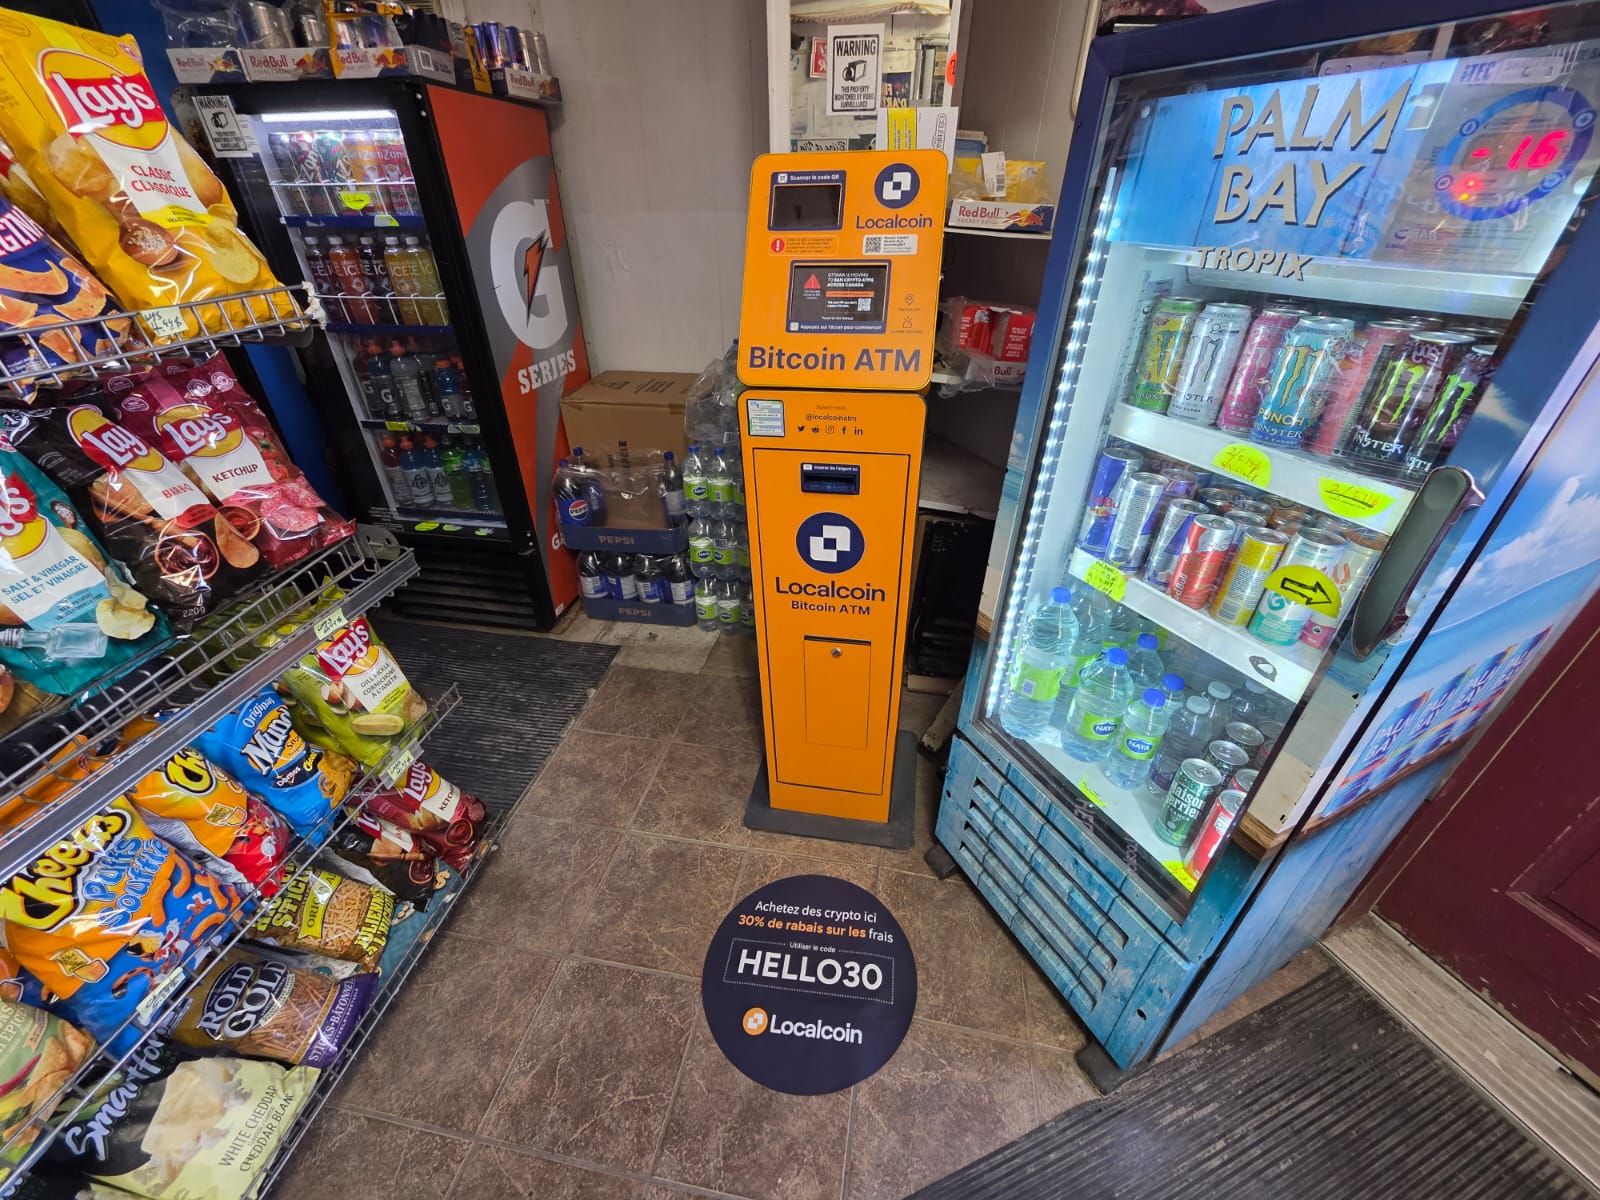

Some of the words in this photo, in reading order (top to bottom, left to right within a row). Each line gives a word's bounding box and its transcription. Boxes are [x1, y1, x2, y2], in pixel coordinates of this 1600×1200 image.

[250, 56, 269, 68] Red
[269, 55, 288, 68] Bull
[353, 51, 369, 63] Bull
[835, 40, 876, 57] WARNING
[51, 72, 156, 129] Lay's
[1213, 77, 1412, 160] PALM
[130, 165, 176, 183] CLASSIC
[130, 180, 192, 199] CLASSIQUE
[1213, 159, 1366, 228] BAY
[856, 214, 933, 230] Localcoin
[959, 206, 979, 218] Red
[979, 207, 1000, 218] Bull
[490, 198, 568, 349] G
[1198, 247, 1313, 281] TROPIX
[518, 350, 577, 394] SERIES
[749, 346, 846, 371] Bitcoin
[854, 349, 921, 372] ATM
[993, 367, 1012, 376] Bull
[805, 413, 857, 422] @localcoinatm
[1256, 408, 1305, 426] PUNCH
[163, 410, 234, 456] Lay's
[212, 463, 259, 483] KETCHUP
[599, 535, 635, 545] PEPSI
[2, 578, 31, 596] SALT
[32, 573, 42, 583] &
[39, 555, 79, 578] VINEGAR
[10, 590, 33, 604] SEL
[33, 583, 47, 596] ET
[47, 562, 89, 587] VINAIGRE
[775, 576, 886, 602] Localcoin
[618, 607, 652, 617] PEPSI
[791, 600, 836, 613] Bitcoin
[839, 604, 871, 615] ATM
[319, 624, 370, 675] Lay's
[243, 696, 276, 728] Original
[1128, 738, 1154, 752] NAYA
[83, 837, 143, 901] Puffs
[755, 901, 800, 916] Achetez
[801, 905, 822, 917] des
[824, 910, 862, 923] crypto
[864, 911, 878, 924] ici
[738, 914, 765, 928] 30%
[767, 917, 784, 930] de
[785, 919, 824, 934] rabais
[826, 926, 846, 937] sur
[848, 926, 867, 938] les
[868, 928, 894, 943] frais
[789, 942, 812, 952] Utiliser
[812, 943, 819, 952] le
[819, 944, 836, 953] code
[737, 949, 883, 991] HELLO30
[200, 965, 255, 1034] ROLD
[223, 960, 289, 1039] GOLD
[770, 1014, 863, 1044] Localcoin
[218, 1130, 252, 1167] WHITE
[245, 1085, 278, 1129] CHEDDAR
[240, 1122, 277, 1172] CHEDDAR
